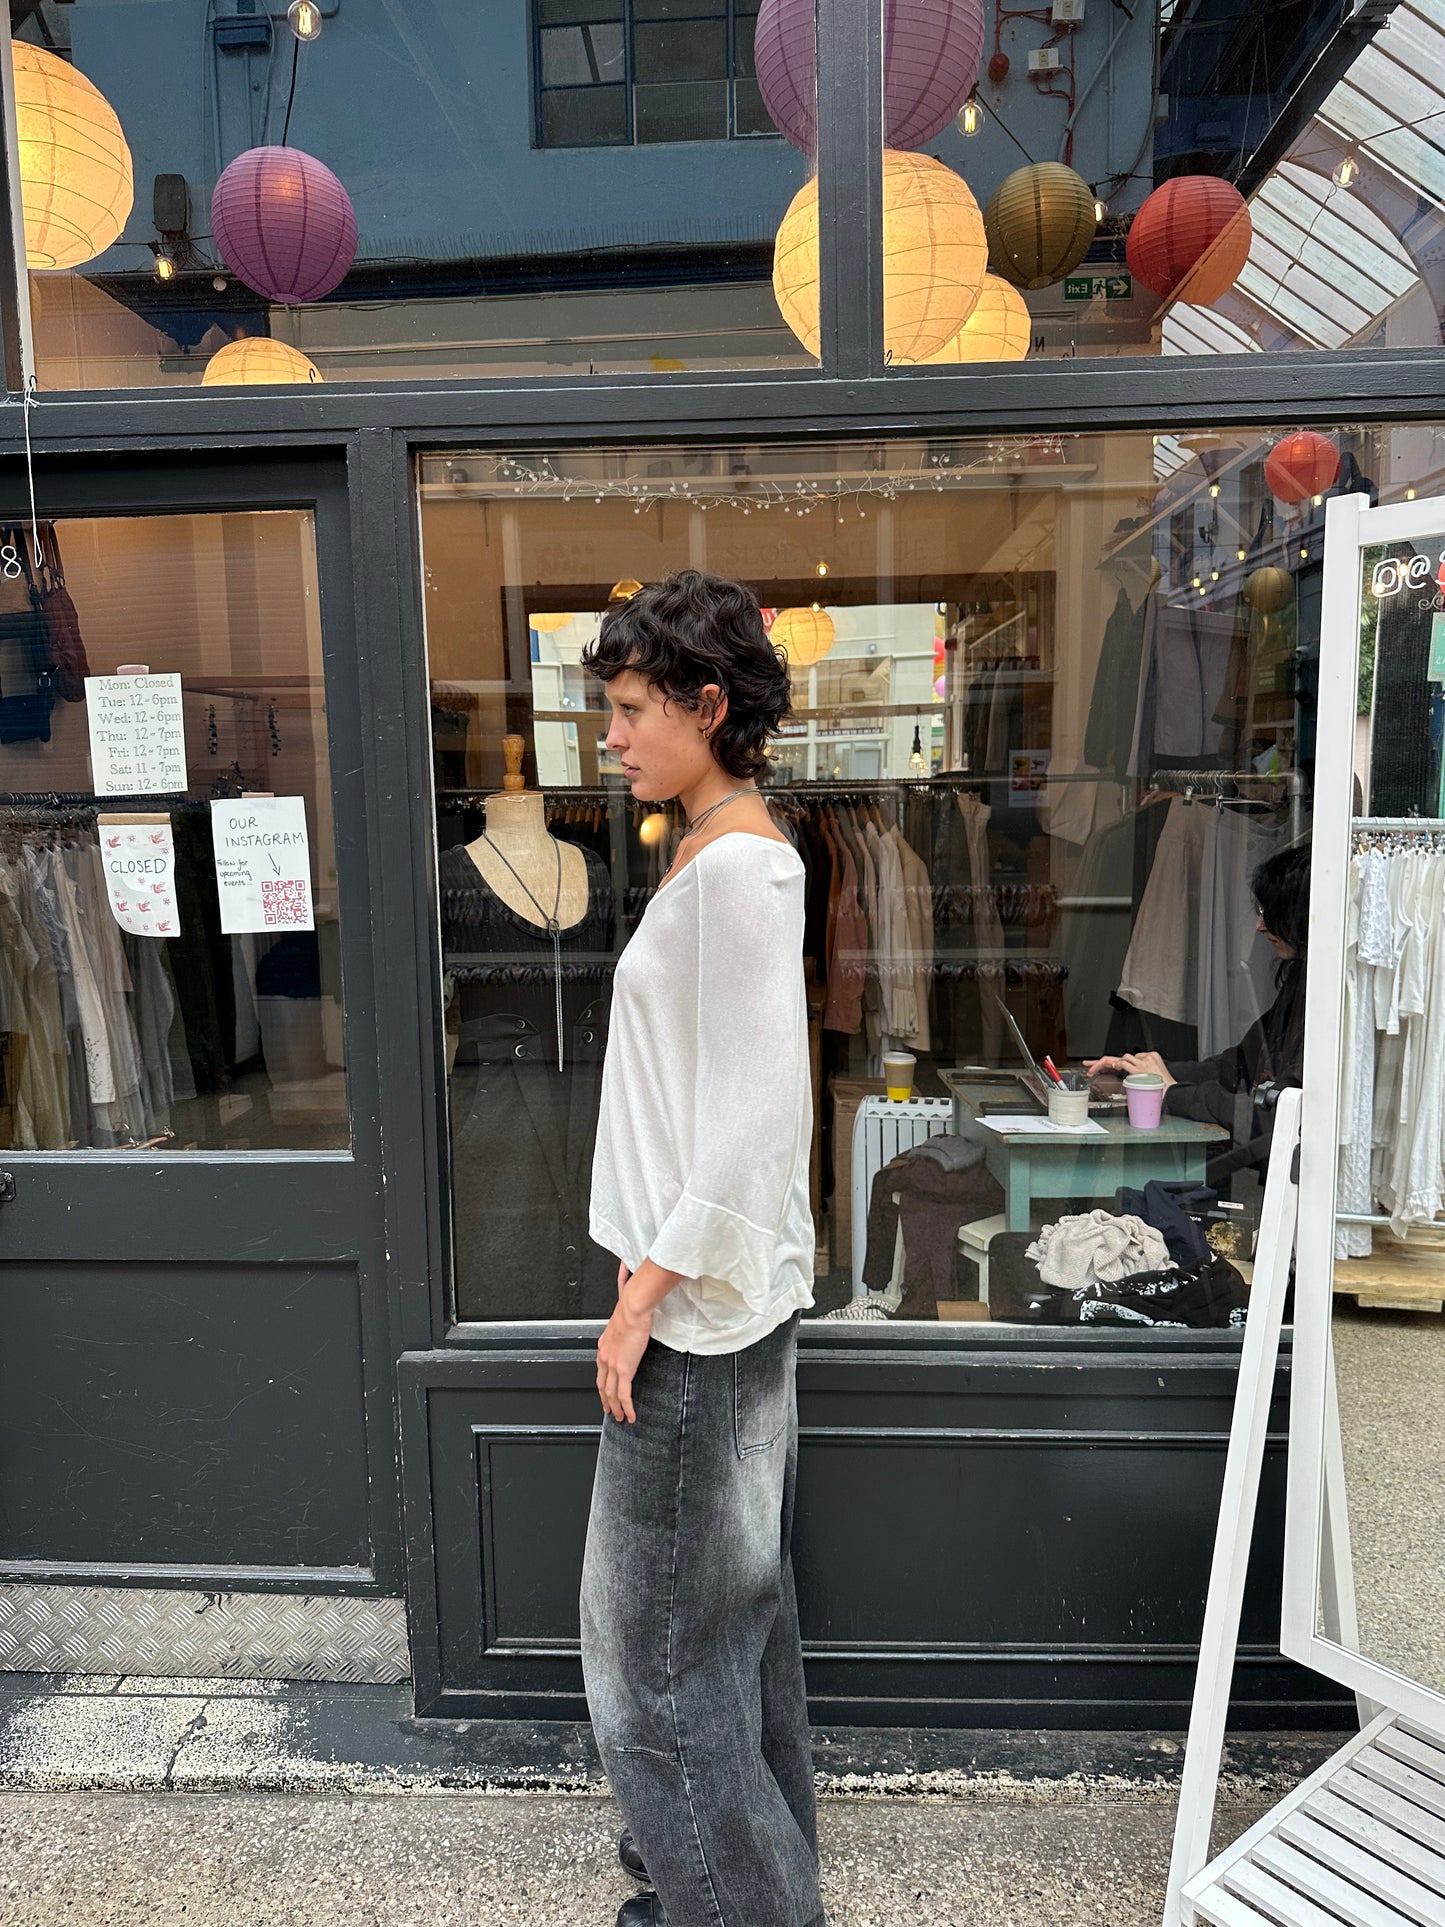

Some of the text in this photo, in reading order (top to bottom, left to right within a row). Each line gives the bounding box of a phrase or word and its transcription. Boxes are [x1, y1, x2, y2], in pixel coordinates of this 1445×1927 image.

[99, 676, 175, 691] Mon: Closed
[98, 696, 126, 708] Tue:
[97, 712, 131, 725] Wed:
[96, 730, 127, 742] Thu:
[108, 746, 130, 758] Fri:
[110, 763, 132, 775] Sat:
[105, 780, 134, 792] Sun:
[229, 816, 259, 830] OUR
[225, 831, 304, 847] INSTAGRAM
[110, 857, 167, 875] CLOSED
[237, 858, 248, 871] for
[219, 870, 253, 881] upcoming
